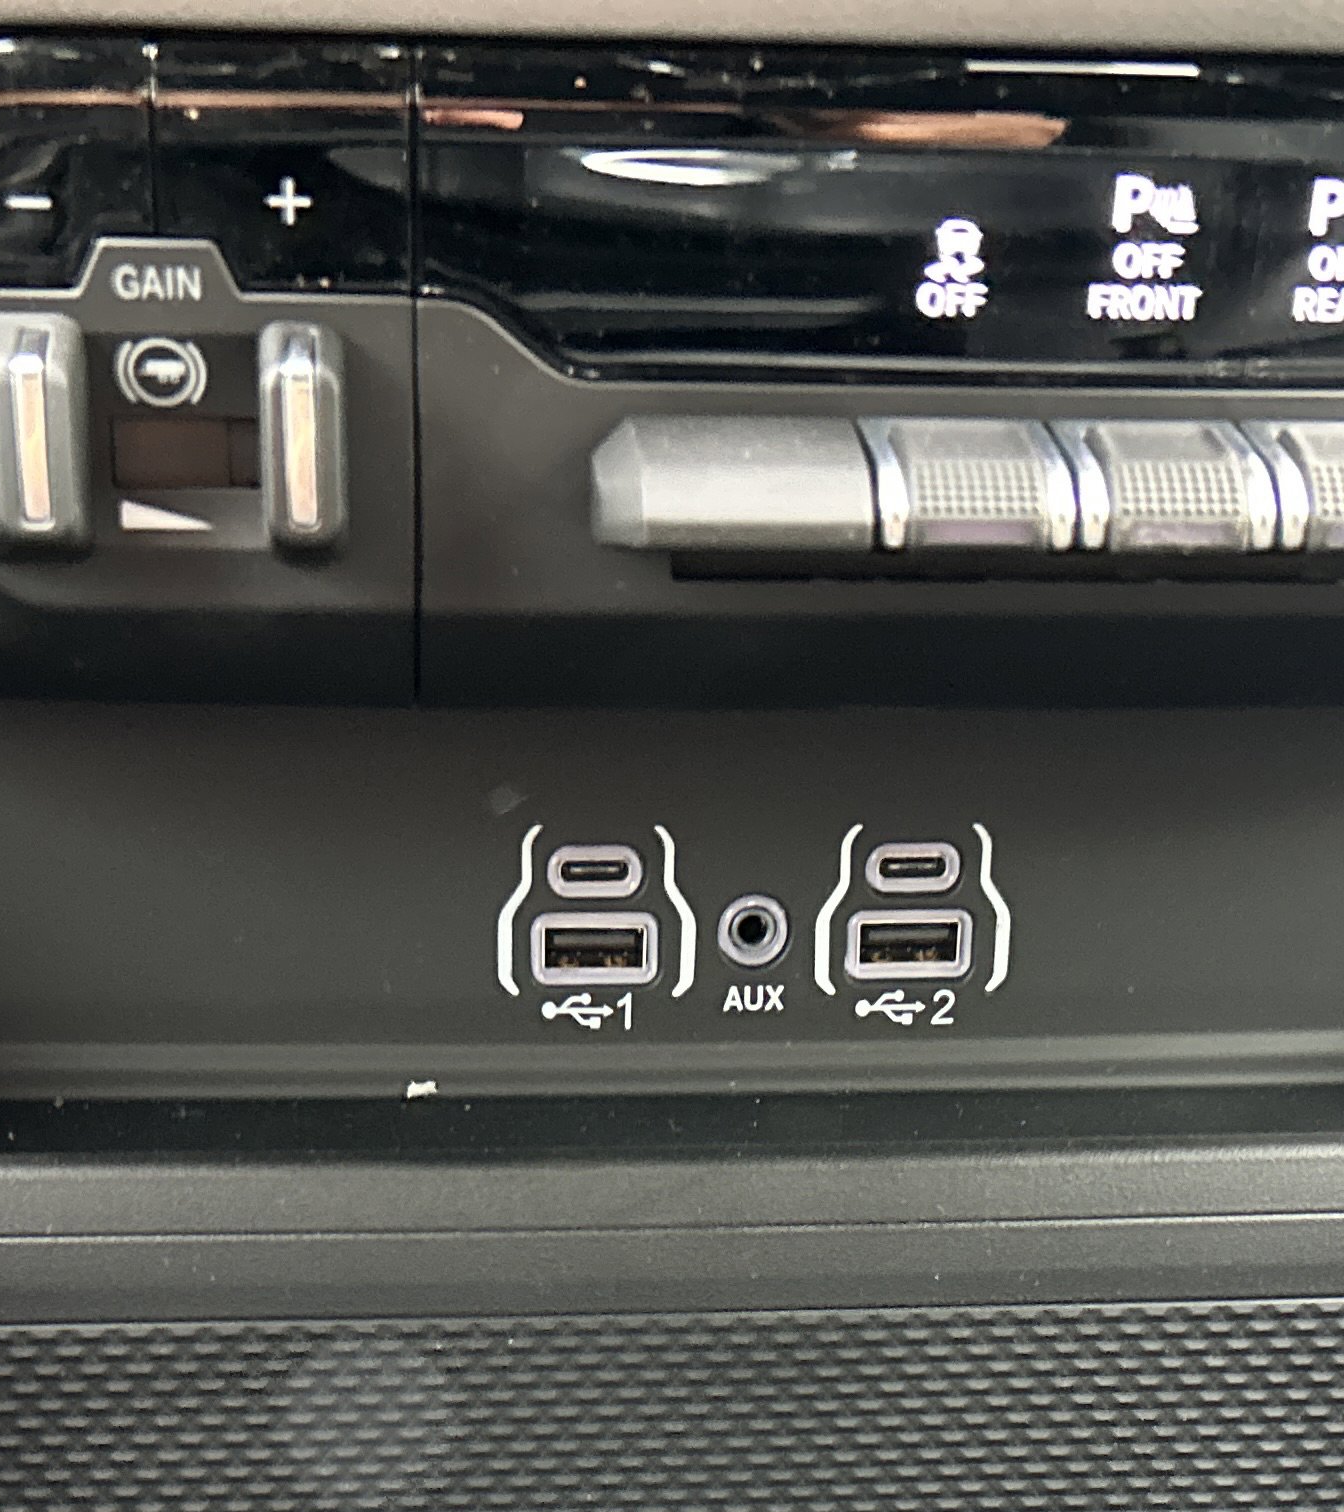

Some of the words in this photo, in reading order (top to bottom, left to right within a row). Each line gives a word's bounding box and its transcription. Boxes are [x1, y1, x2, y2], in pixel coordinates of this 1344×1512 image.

[1112, 242, 1186, 279] OFF
[111, 264, 203, 301] GAIN
[915, 281, 989, 318] OFF
[1087, 283, 1203, 321] FRONT
[616, 992, 633, 1030] 1
[722, 984, 785, 1012] AUX
[930, 988, 956, 1026] 2
